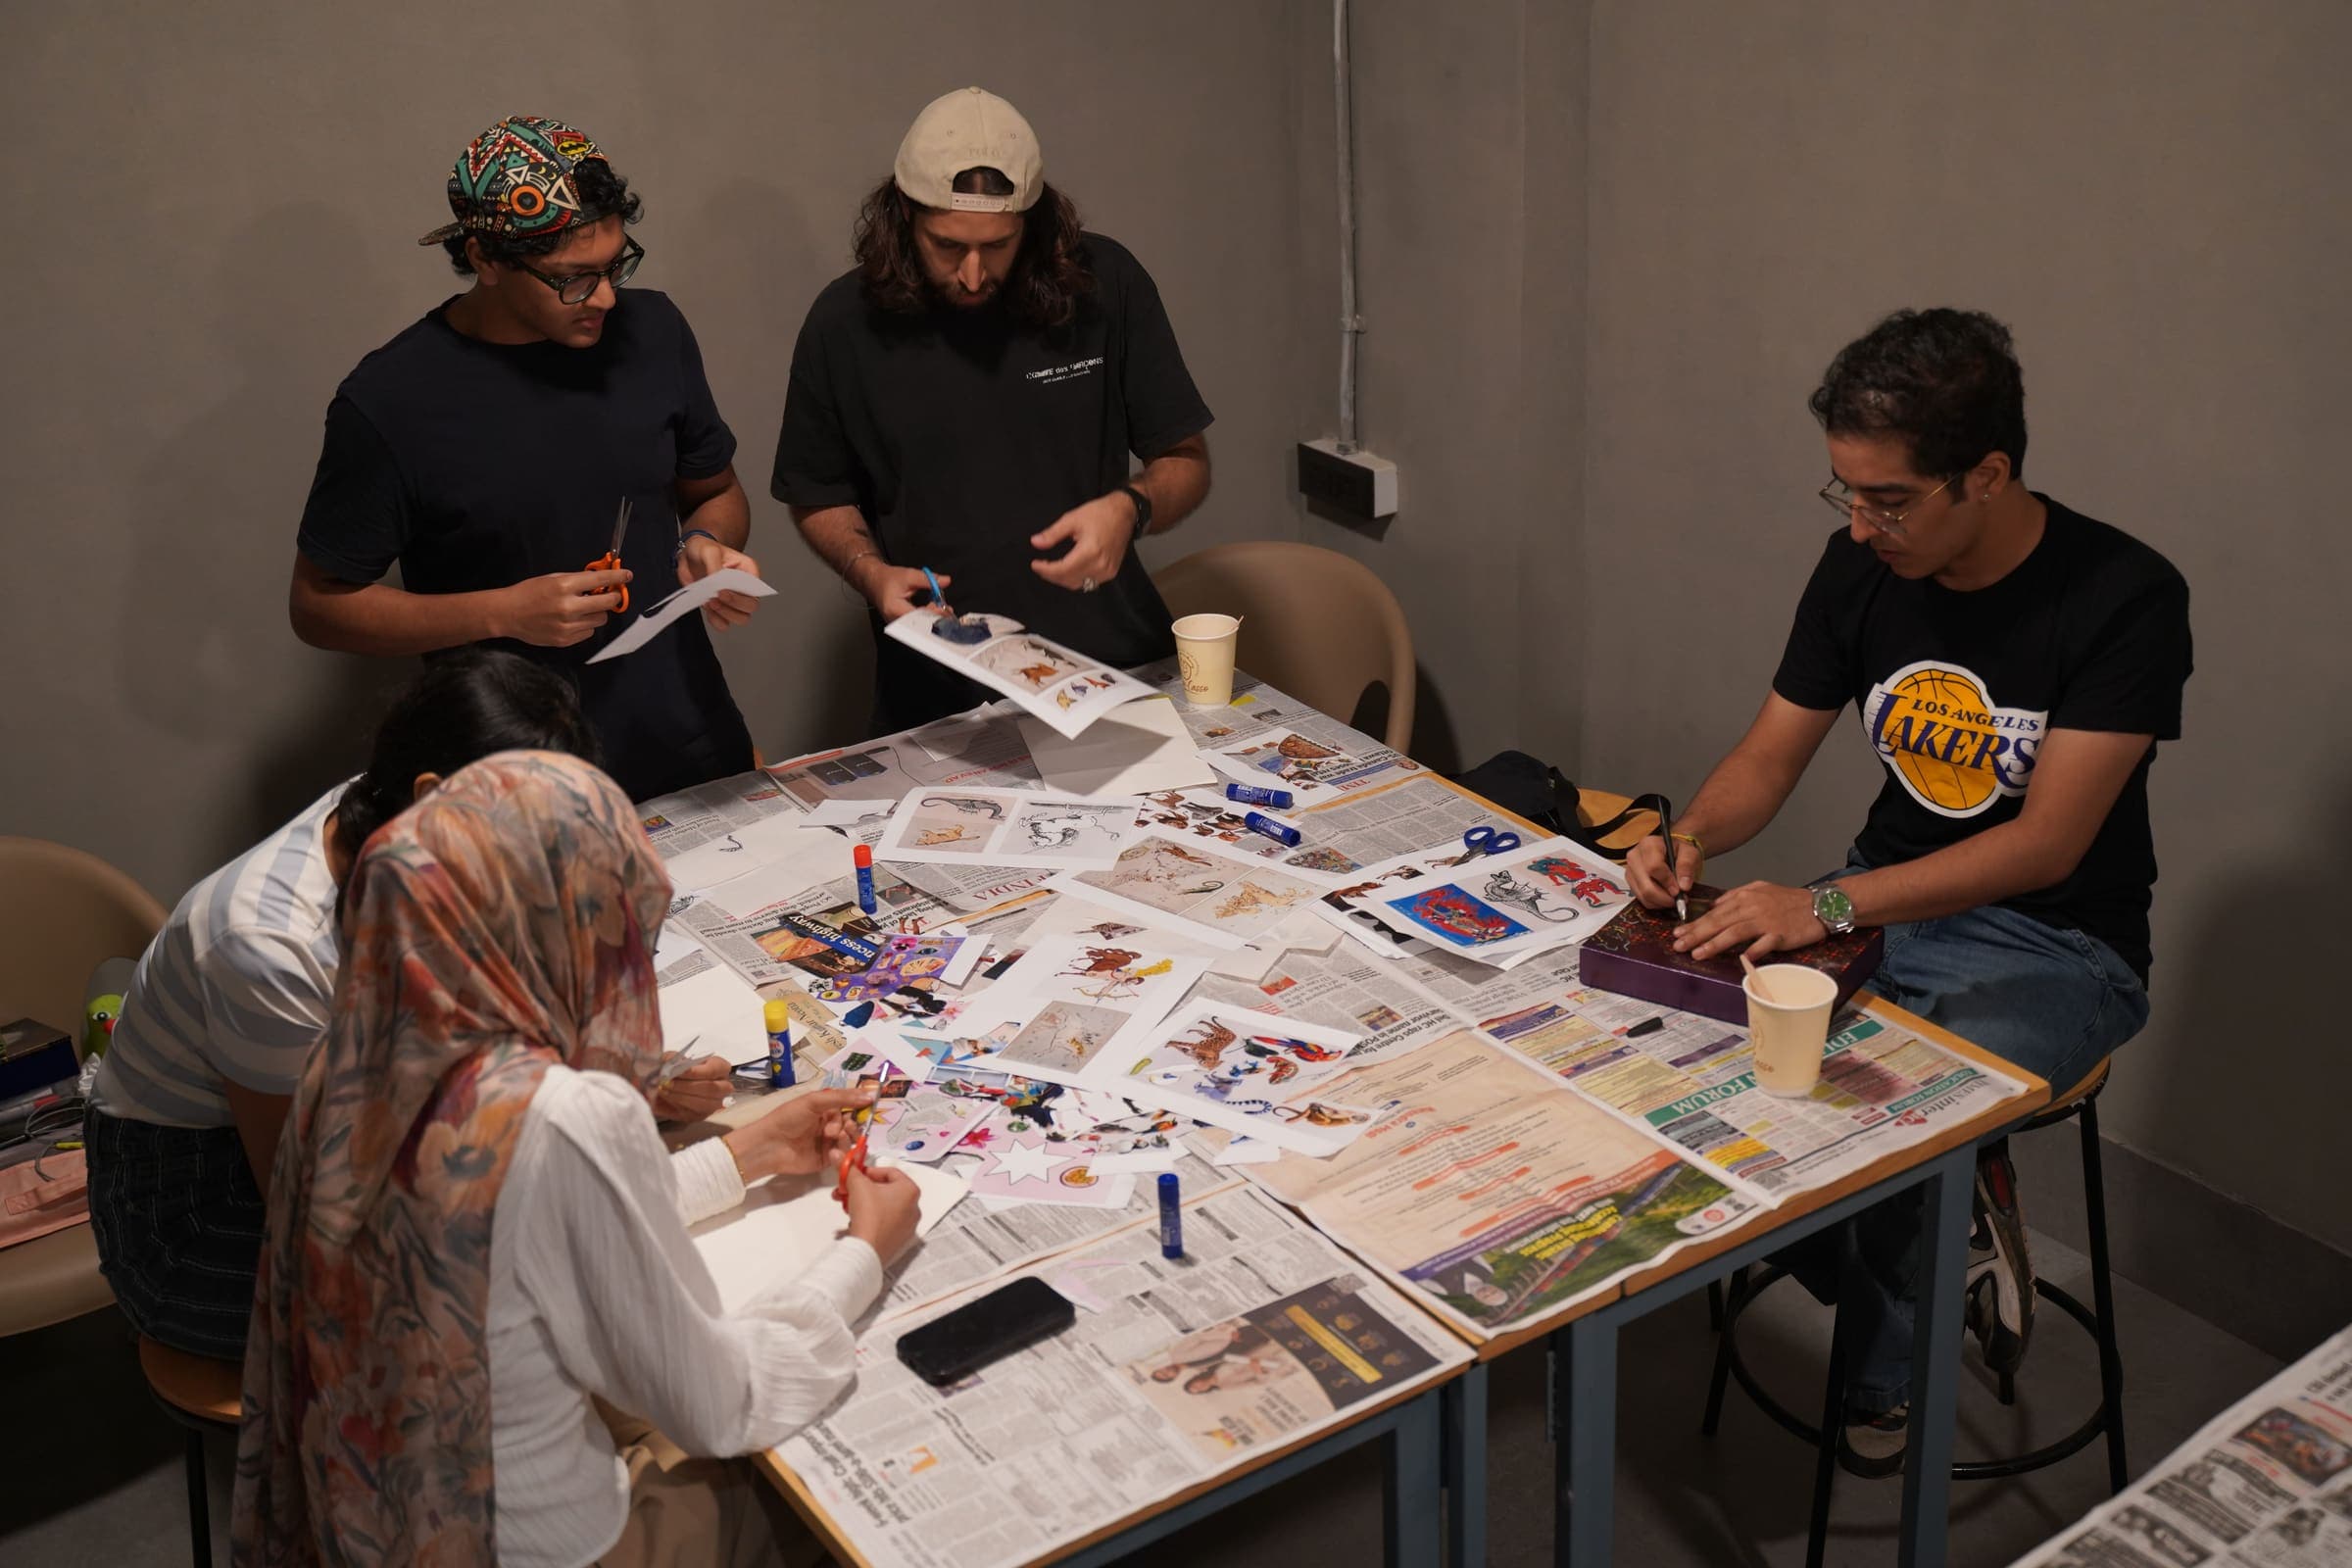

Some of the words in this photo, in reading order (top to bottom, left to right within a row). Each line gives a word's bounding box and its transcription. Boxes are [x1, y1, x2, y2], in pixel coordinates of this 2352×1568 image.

[1912, 699, 1949, 715] LOS
[1949, 709, 2039, 731] ANGELES
[1872, 691, 2040, 789] LAKERS
[972, 879, 1034, 900] INDIA
[789, 915, 842, 942] highway
[840, 938, 875, 960] ncess
[1377, 1035, 1404, 1049] Centre
[1670, 1079, 1749, 1114] FORUM
